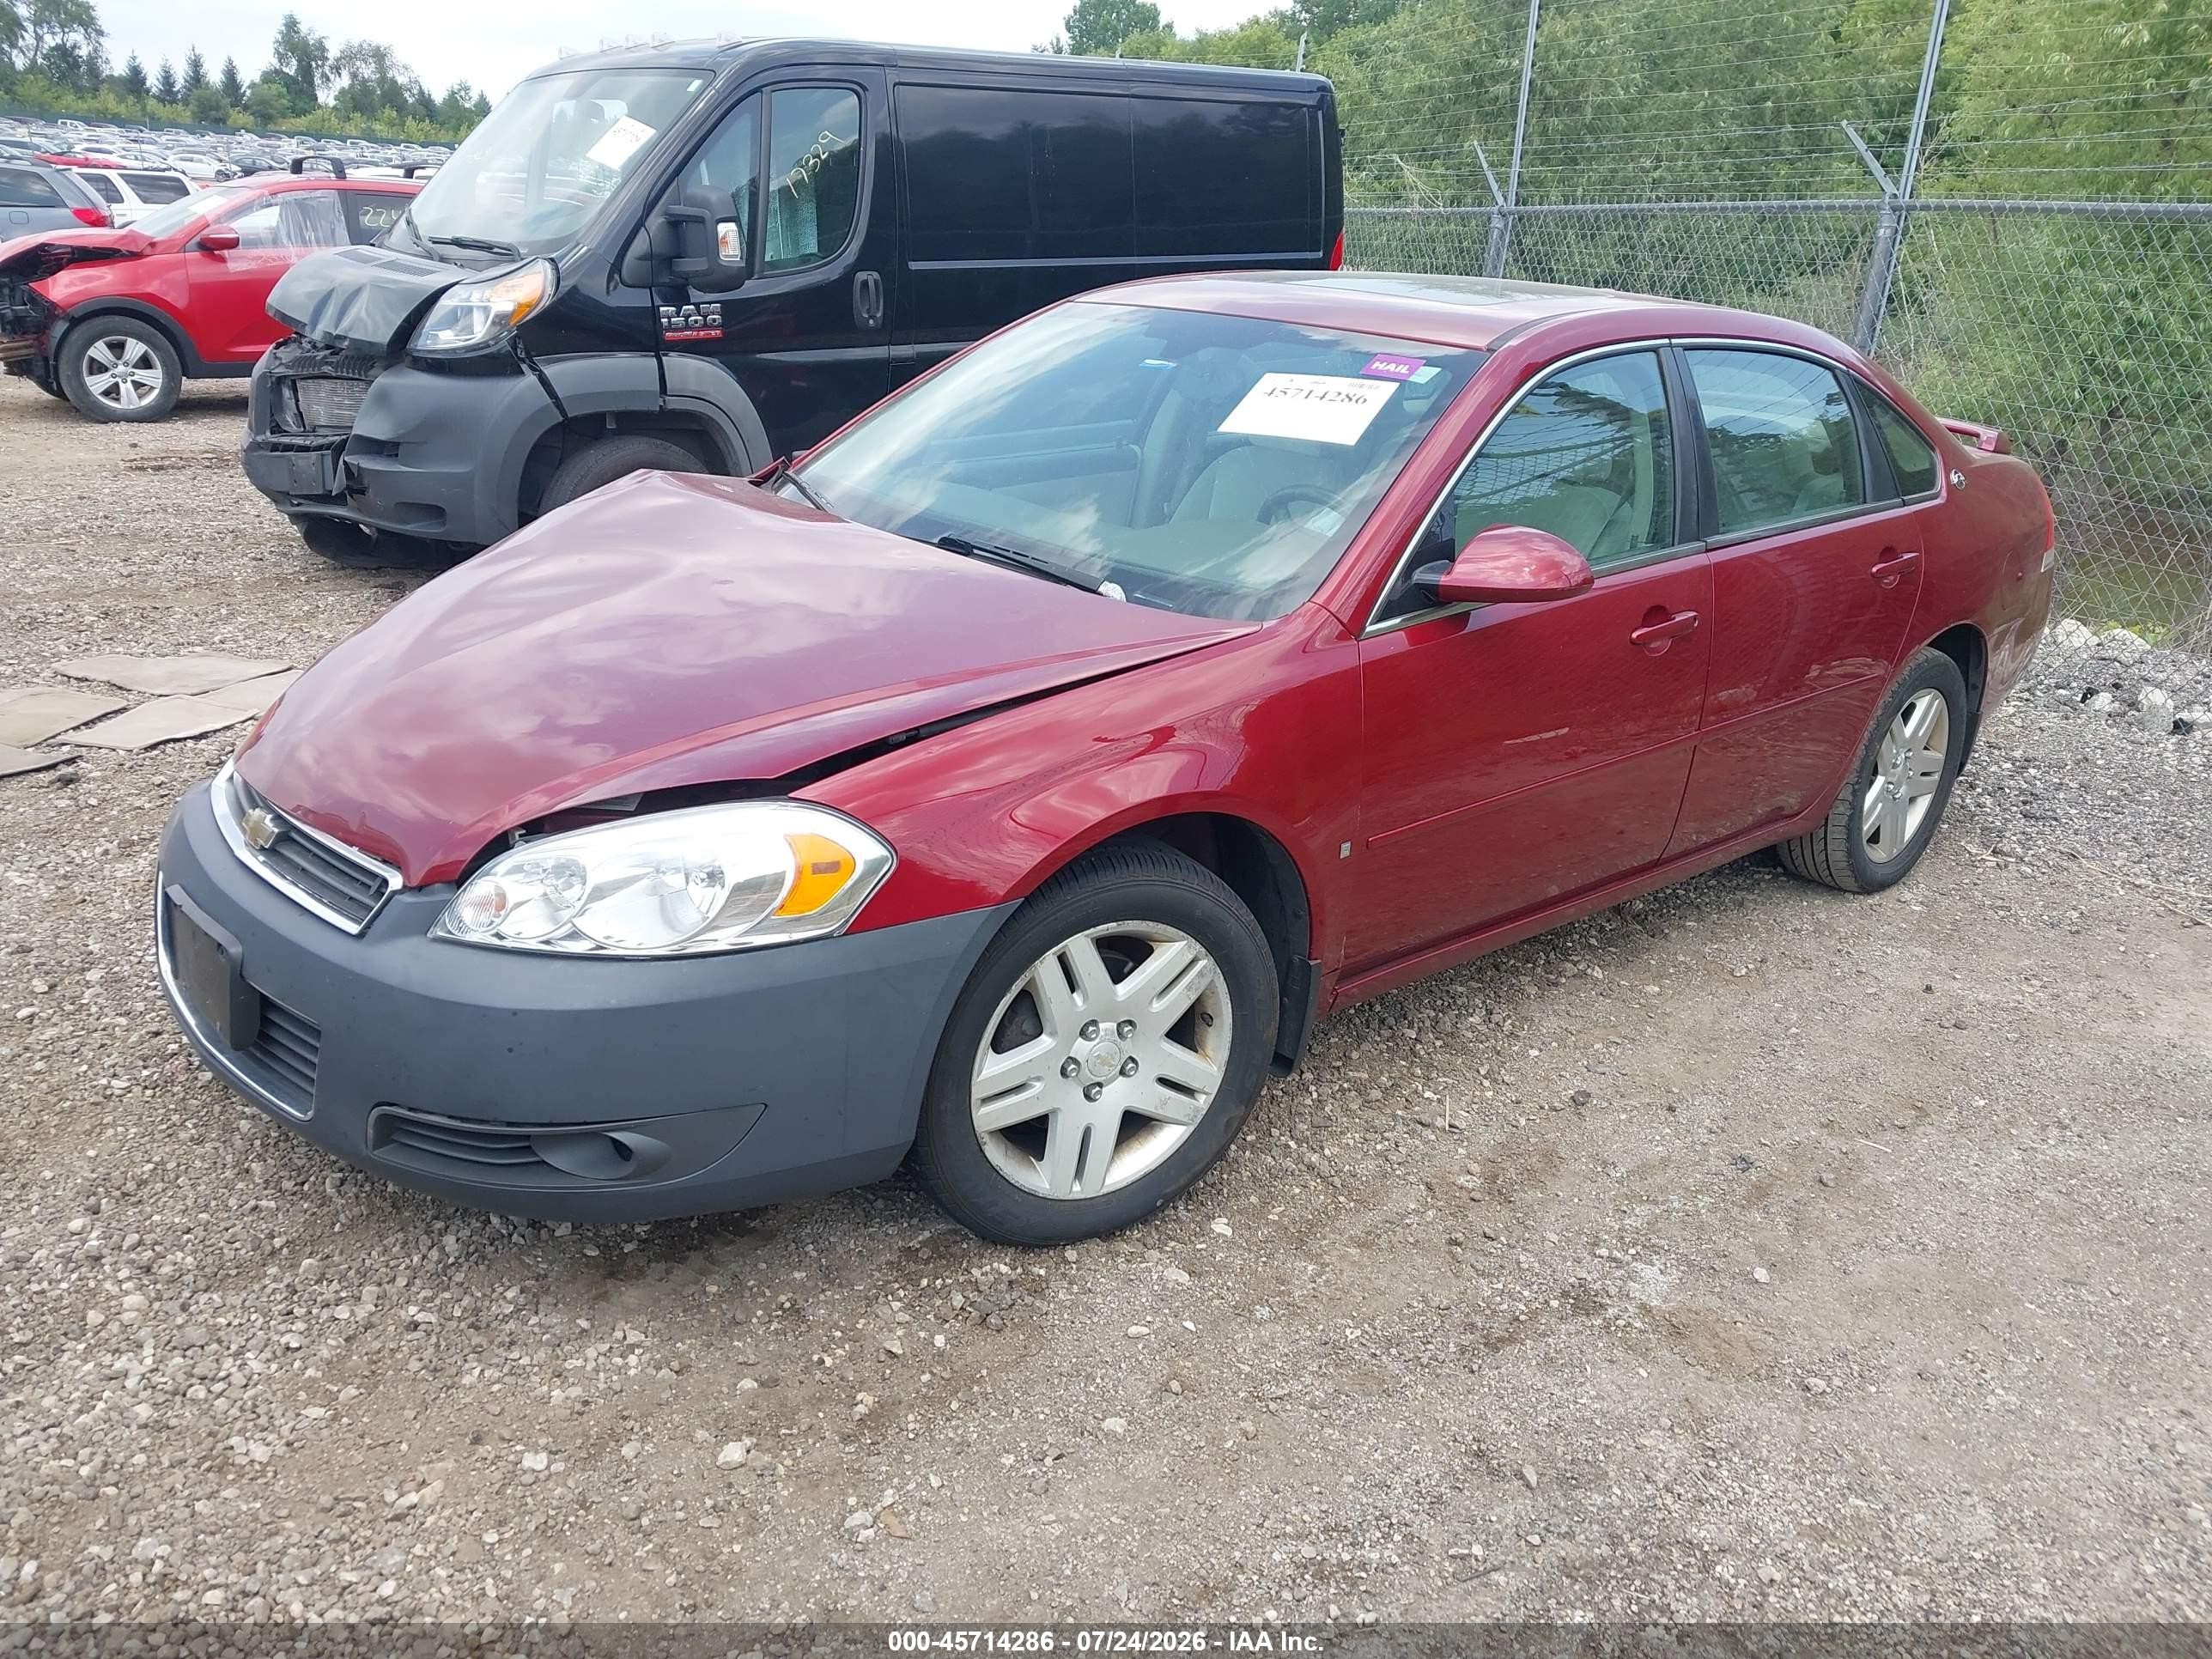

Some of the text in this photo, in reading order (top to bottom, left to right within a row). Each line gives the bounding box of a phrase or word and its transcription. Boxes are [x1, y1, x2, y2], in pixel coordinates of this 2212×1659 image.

[786, 130, 846, 199] 17329
[659, 303, 721, 318] RAM
[660, 315, 722, 329] 1500
[1370, 361, 1411, 374] HAIL
[1263, 386, 1368, 406] 45714286
